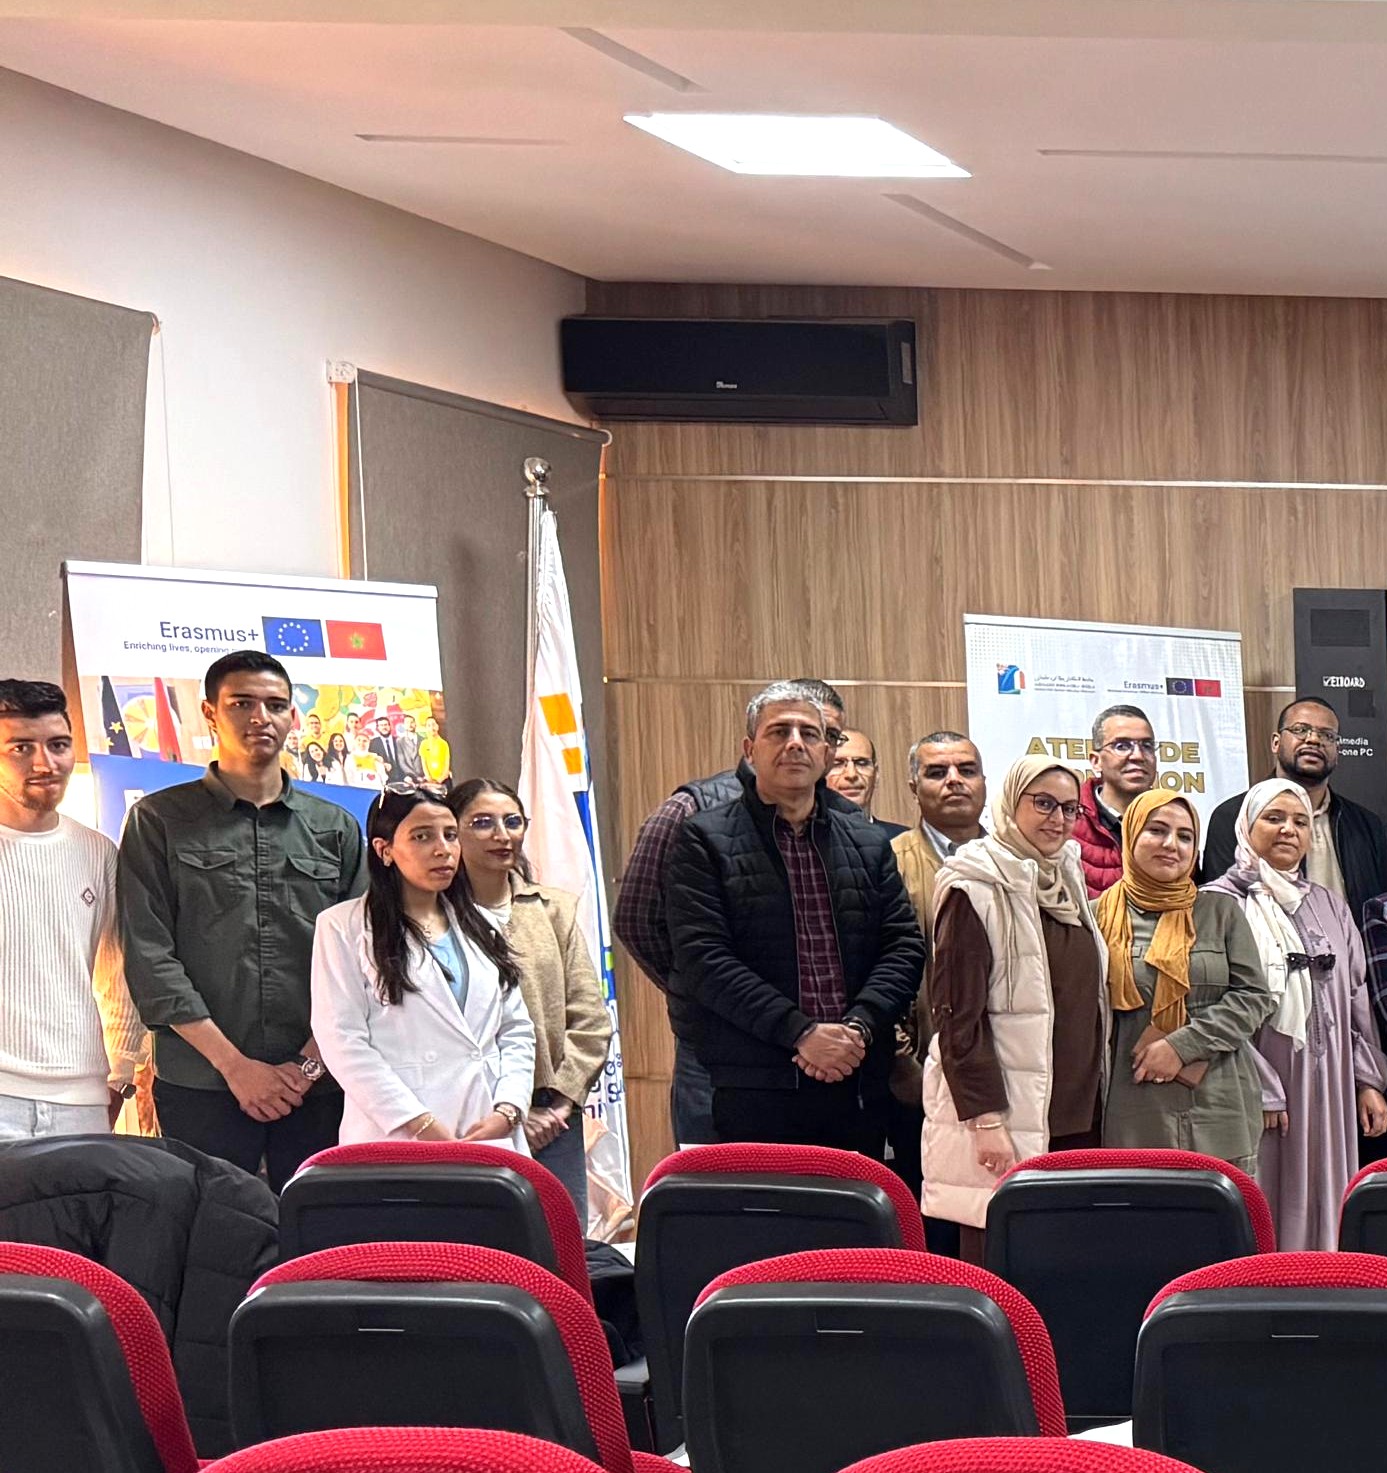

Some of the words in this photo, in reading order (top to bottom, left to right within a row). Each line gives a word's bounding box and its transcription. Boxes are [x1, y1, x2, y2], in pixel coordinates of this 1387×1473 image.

[159, 621, 259, 642] Erasmus+
[123, 641, 167, 653] Enriching
[169, 643, 192, 653] lives,
[1123, 681, 1164, 690] Erasmus+
[1159, 741, 1201, 763] DE
[1360, 748, 1374, 756] PC
